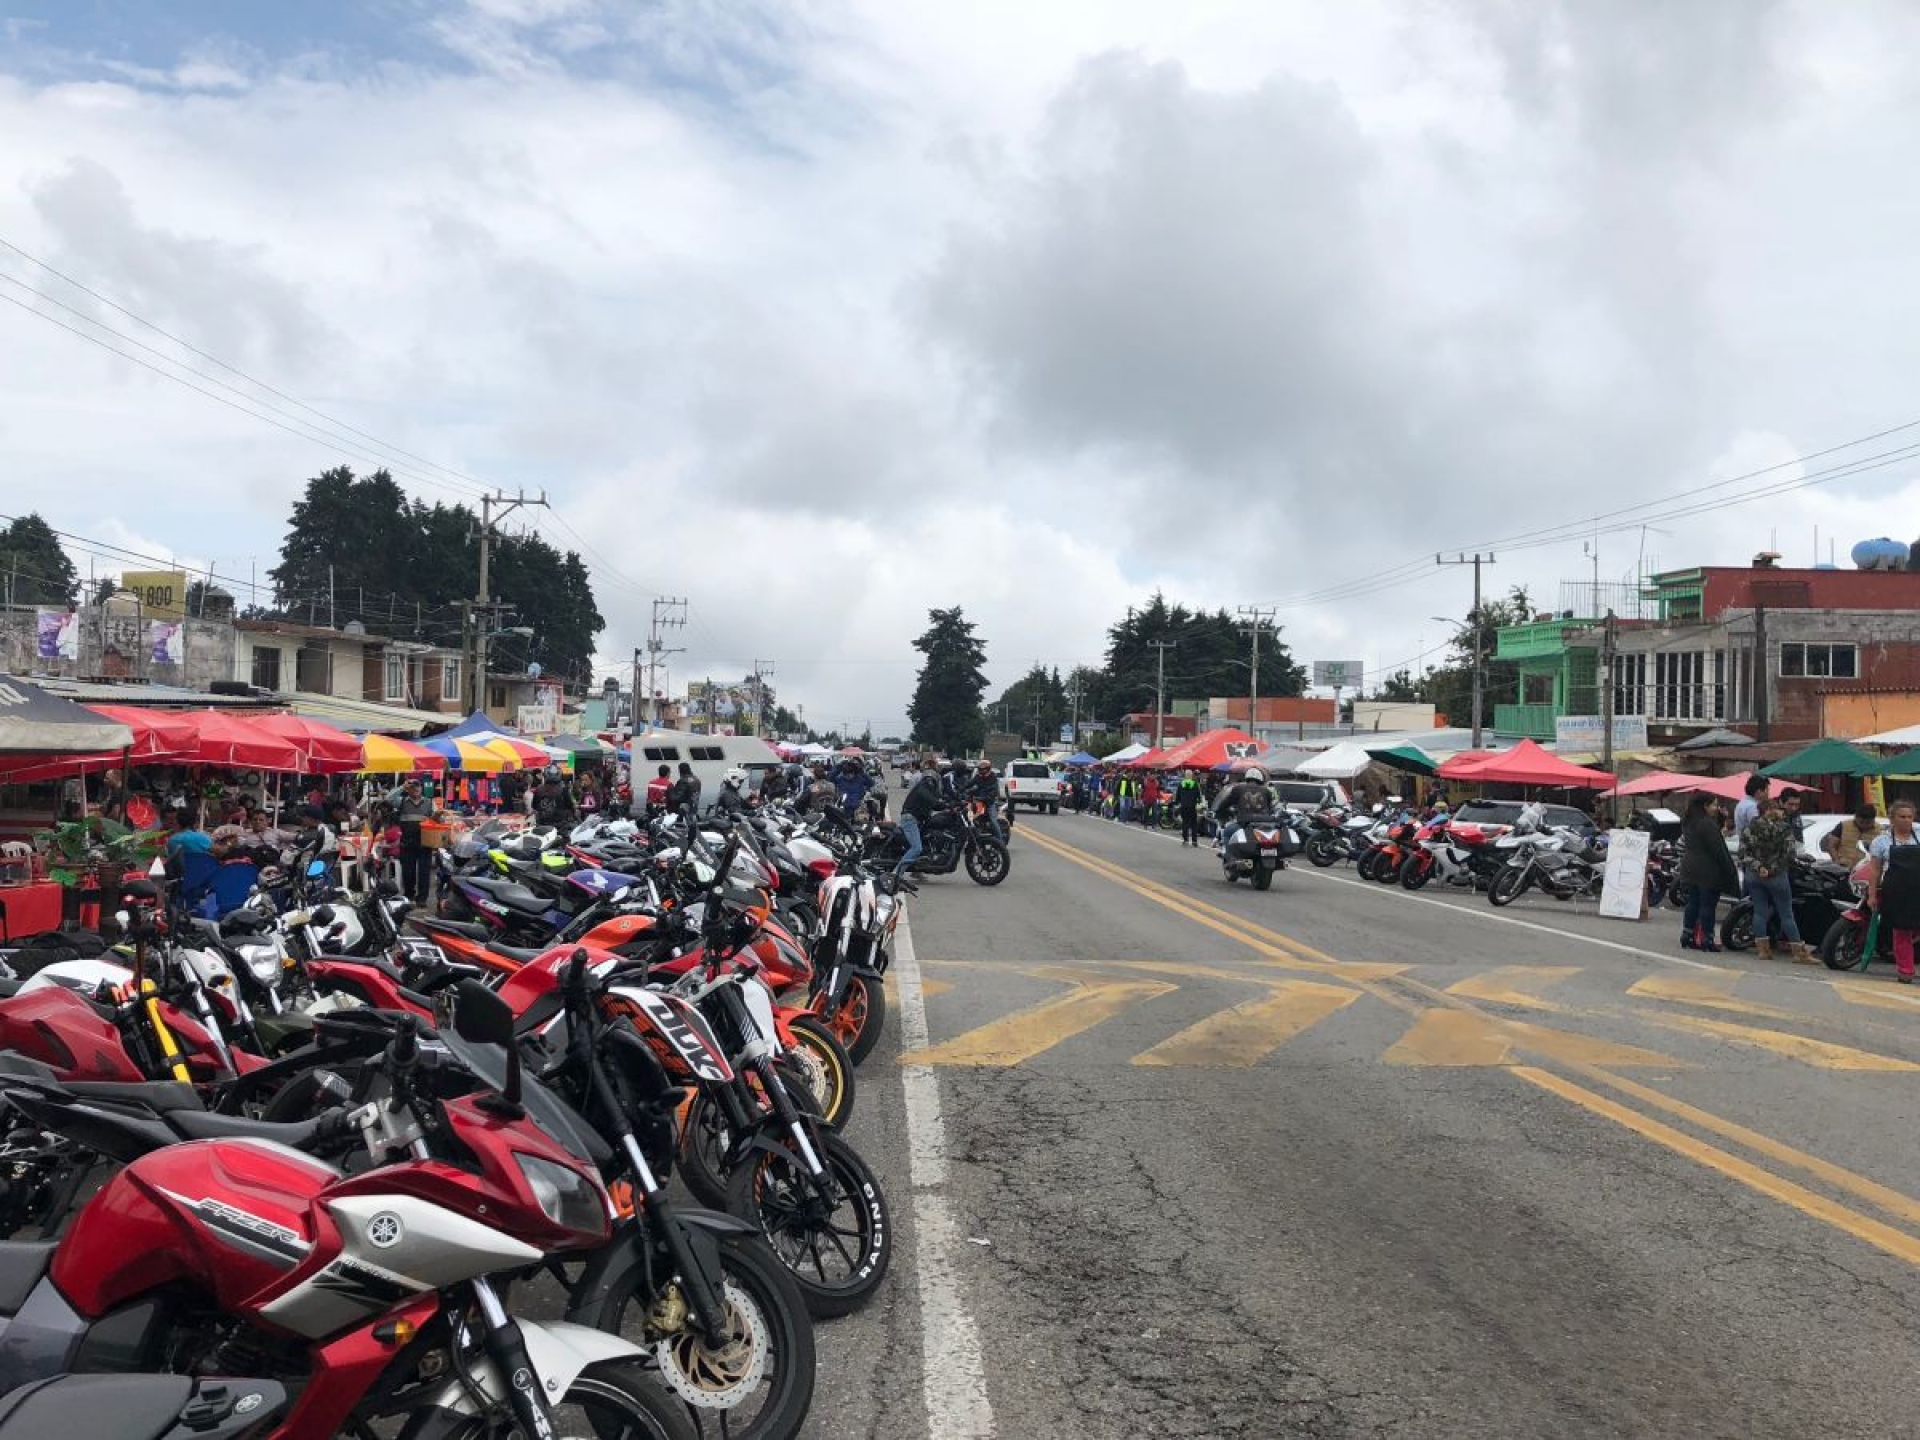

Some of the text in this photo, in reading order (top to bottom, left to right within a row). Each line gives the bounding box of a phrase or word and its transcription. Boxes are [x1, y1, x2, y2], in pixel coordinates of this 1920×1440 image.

[147, 585, 172, 607] 800
[199, 1198, 299, 1242] FAZER
[858, 1182, 883, 1279] RACING
